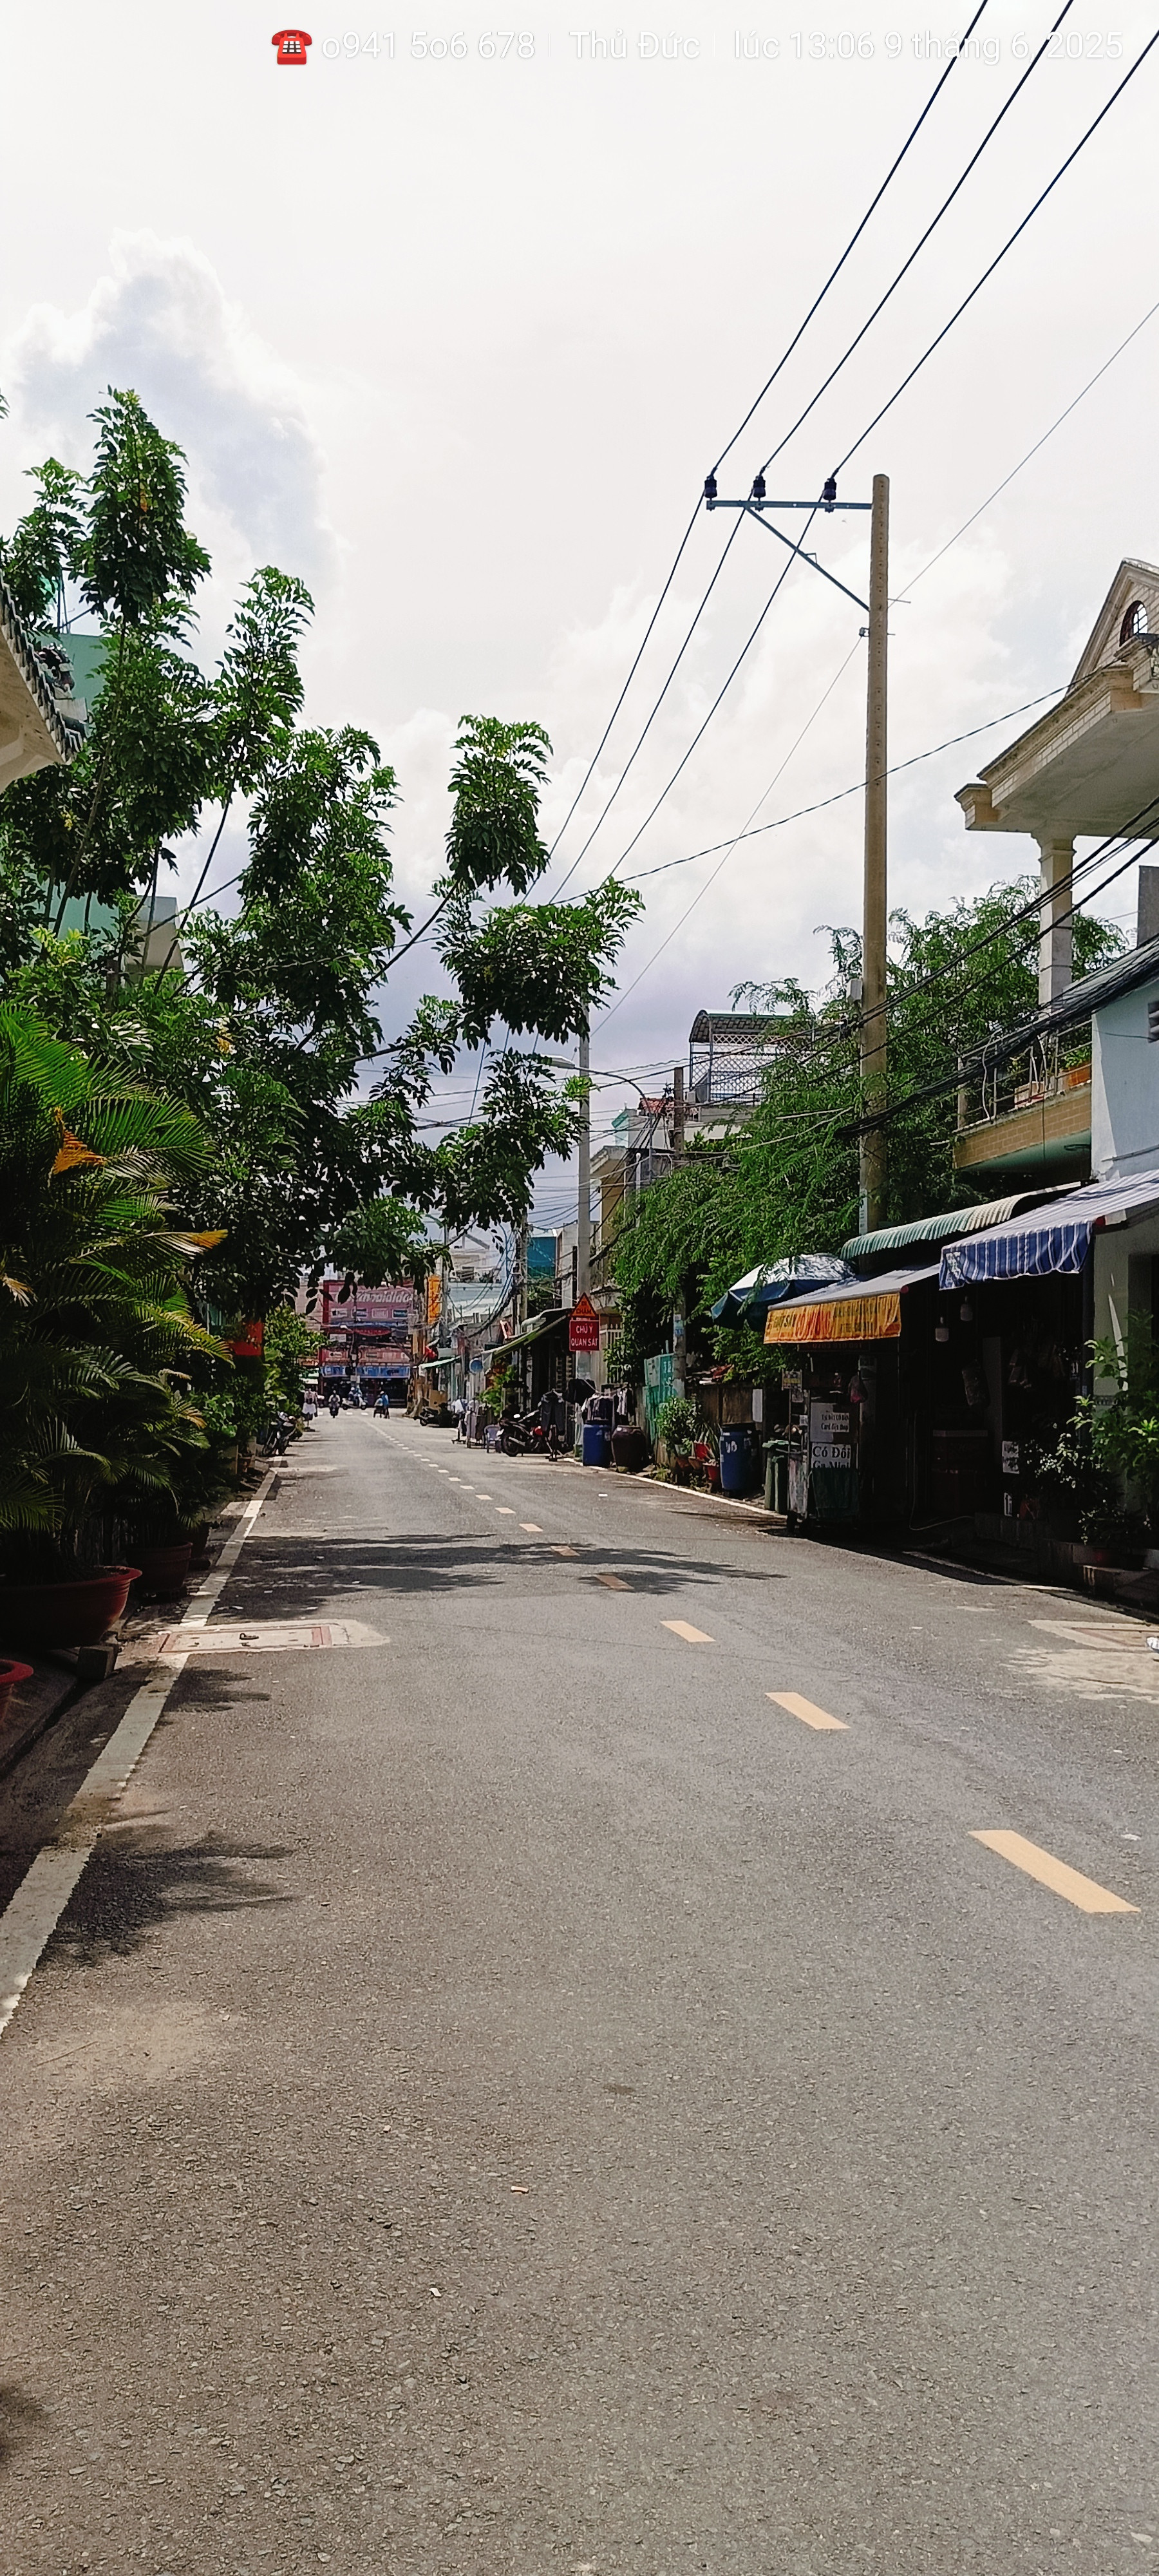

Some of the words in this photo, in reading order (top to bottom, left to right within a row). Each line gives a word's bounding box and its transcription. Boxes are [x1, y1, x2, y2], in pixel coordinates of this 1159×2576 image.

[576, 1323, 588, 1334] CHÚ
[589, 1323, 593, 1334] Ý
[571, 1338, 587, 1347] QUAN
[588, 1336, 598, 1347] SÁT
[813, 1446, 828, 1457] Có
[832, 1444, 851, 1459] Đổi
